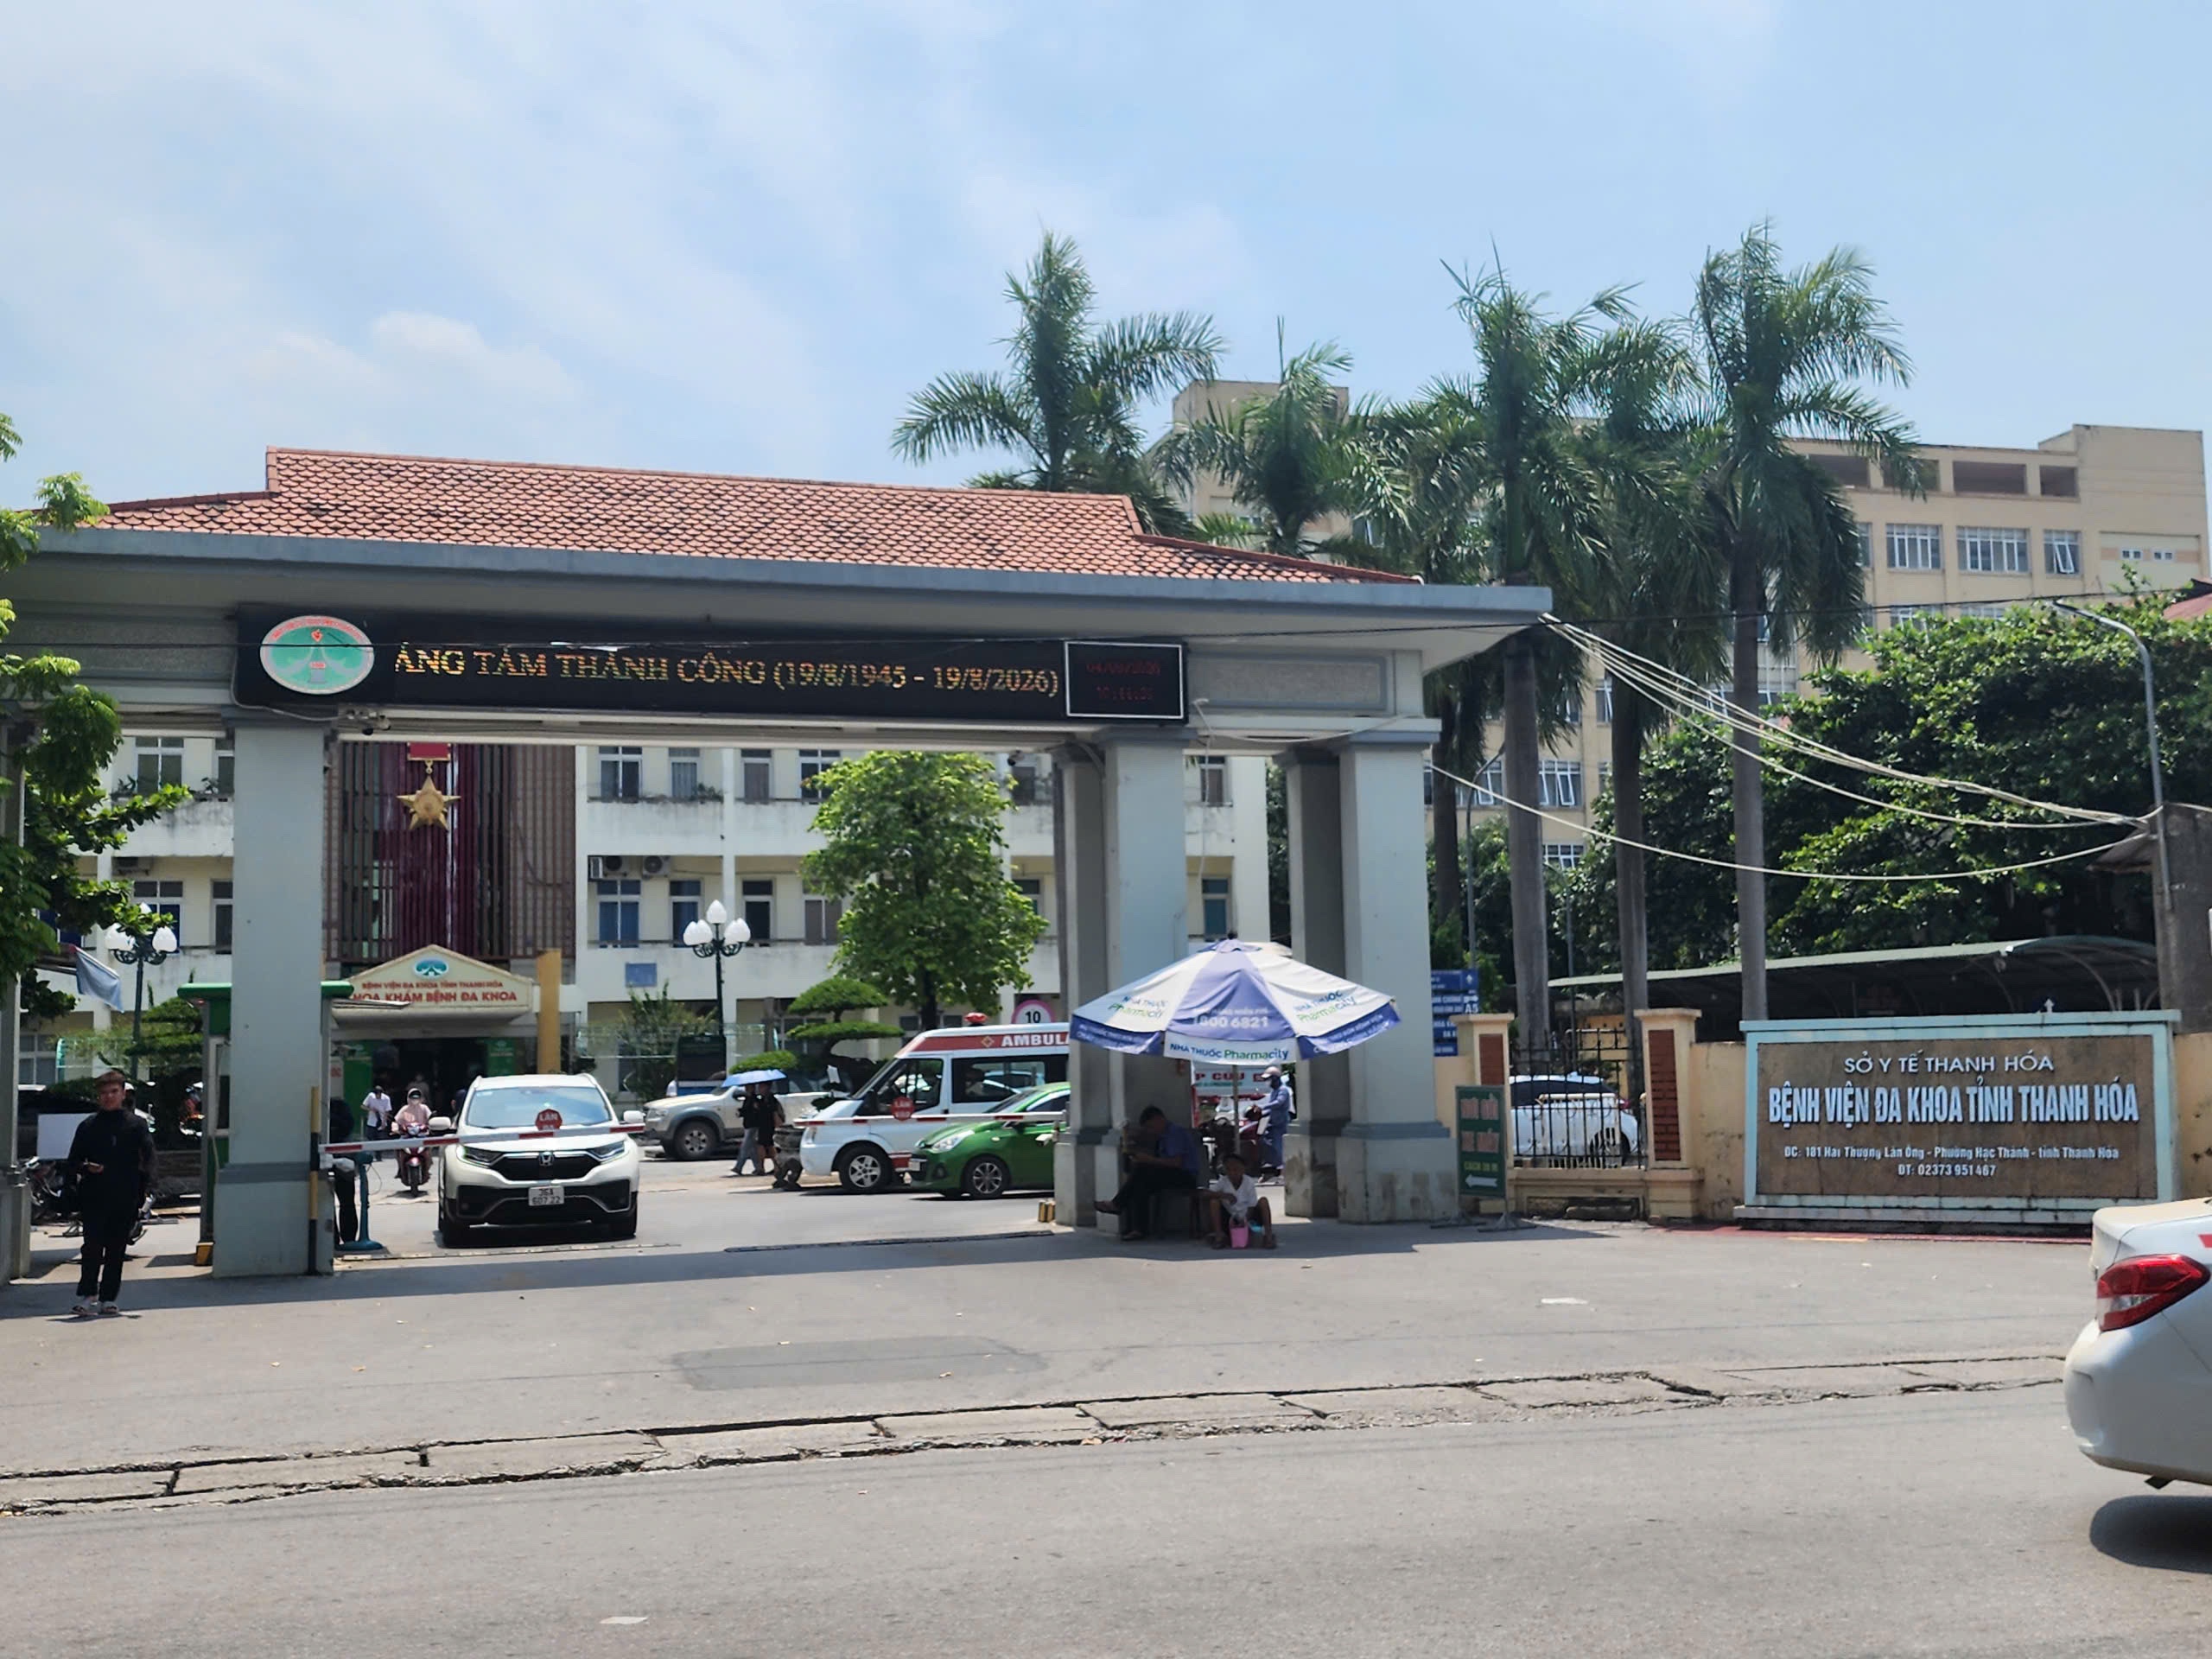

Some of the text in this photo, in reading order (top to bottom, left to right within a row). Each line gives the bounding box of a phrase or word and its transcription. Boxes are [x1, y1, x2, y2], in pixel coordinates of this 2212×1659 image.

[677, 651, 766, 684] CÔNG
[353, 993, 380, 1001] HOA
[481, 991, 518, 1001] KHOA
[1025, 1010, 1042, 1023] 10
[1224, 1047, 1289, 1060] Pharmacity
[1844, 1048, 2055, 1074] SỞ Y TẾ THANH HÓA
[1768, 1075, 2140, 1128] BỆNH VIỆN ĐA KHOA TỈNH THANH HÓA
[1917, 1164, 1952, 1176] 02373
